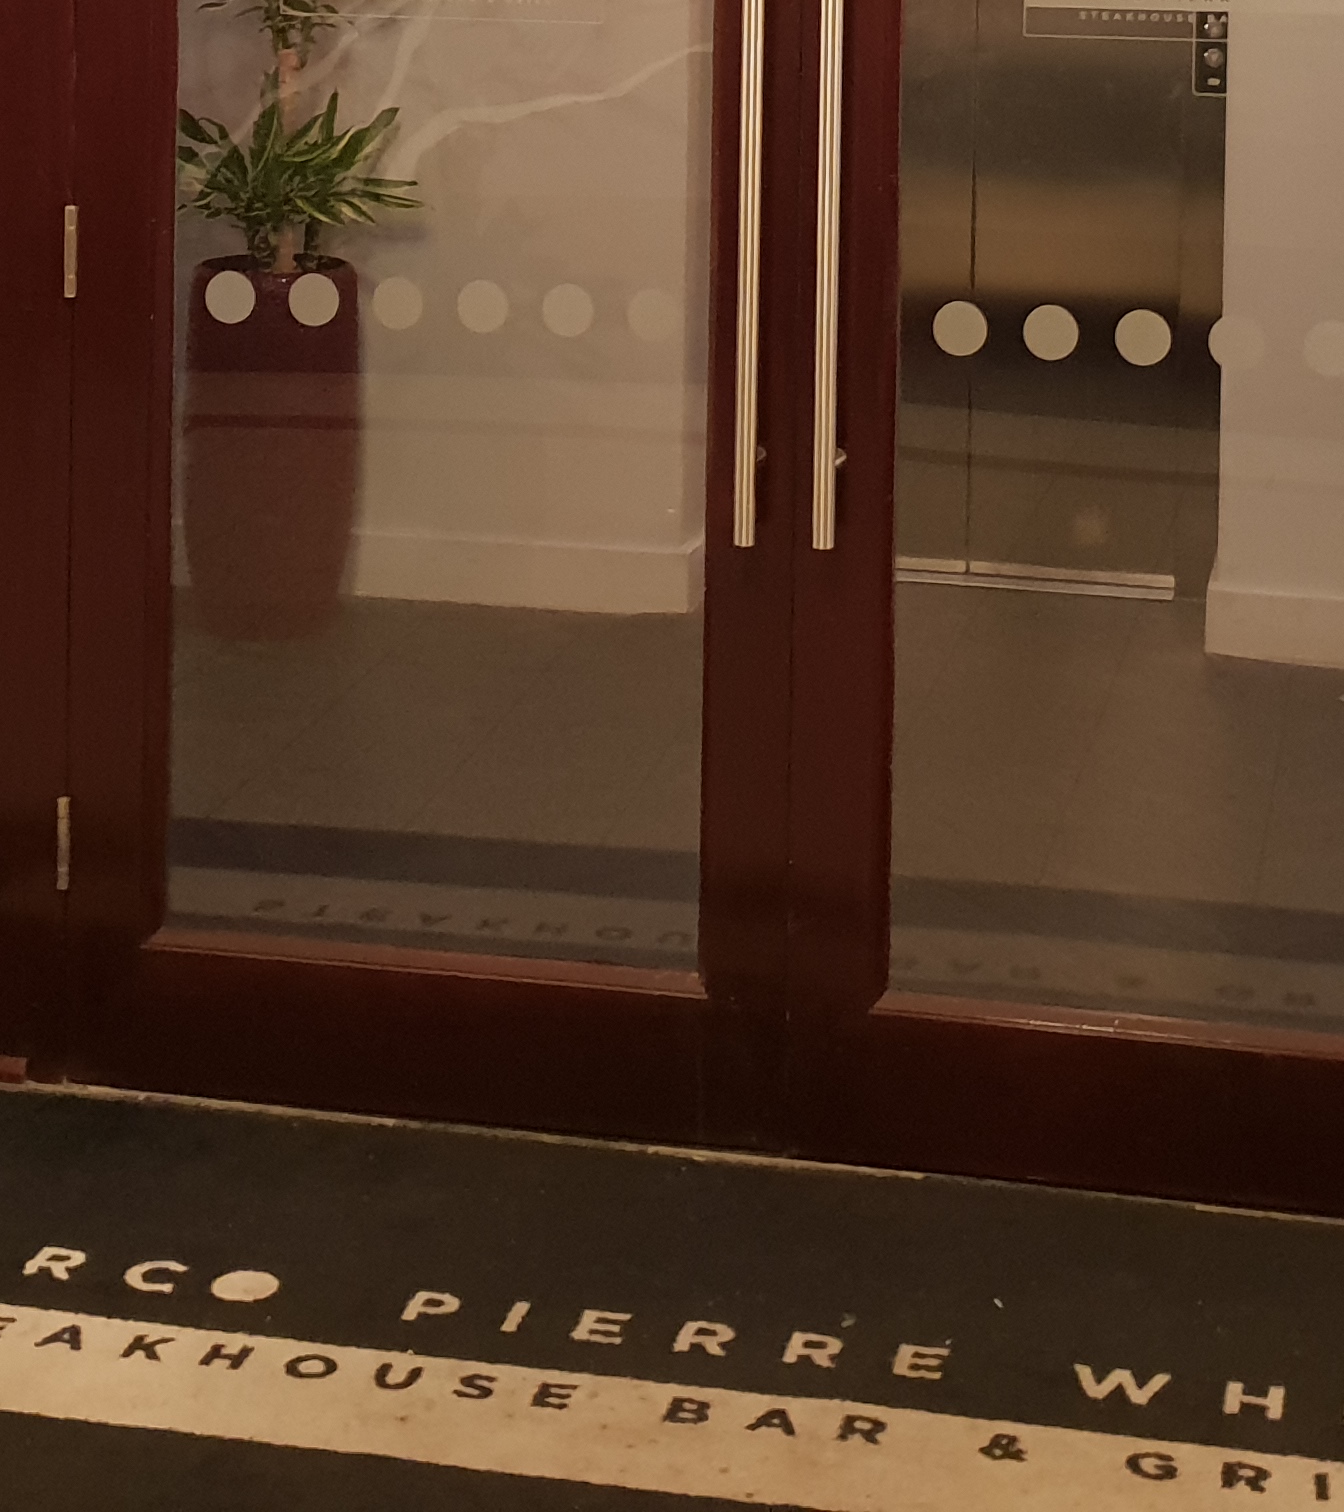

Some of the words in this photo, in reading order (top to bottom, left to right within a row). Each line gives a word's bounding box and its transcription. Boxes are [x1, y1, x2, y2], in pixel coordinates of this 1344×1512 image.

[1078, 10, 1195, 23] STEAKHOUSE
[401, 1289, 954, 1382] PIERRE
[661, 1395, 889, 1446] BAR
[976, 1432, 1030, 1464] &
